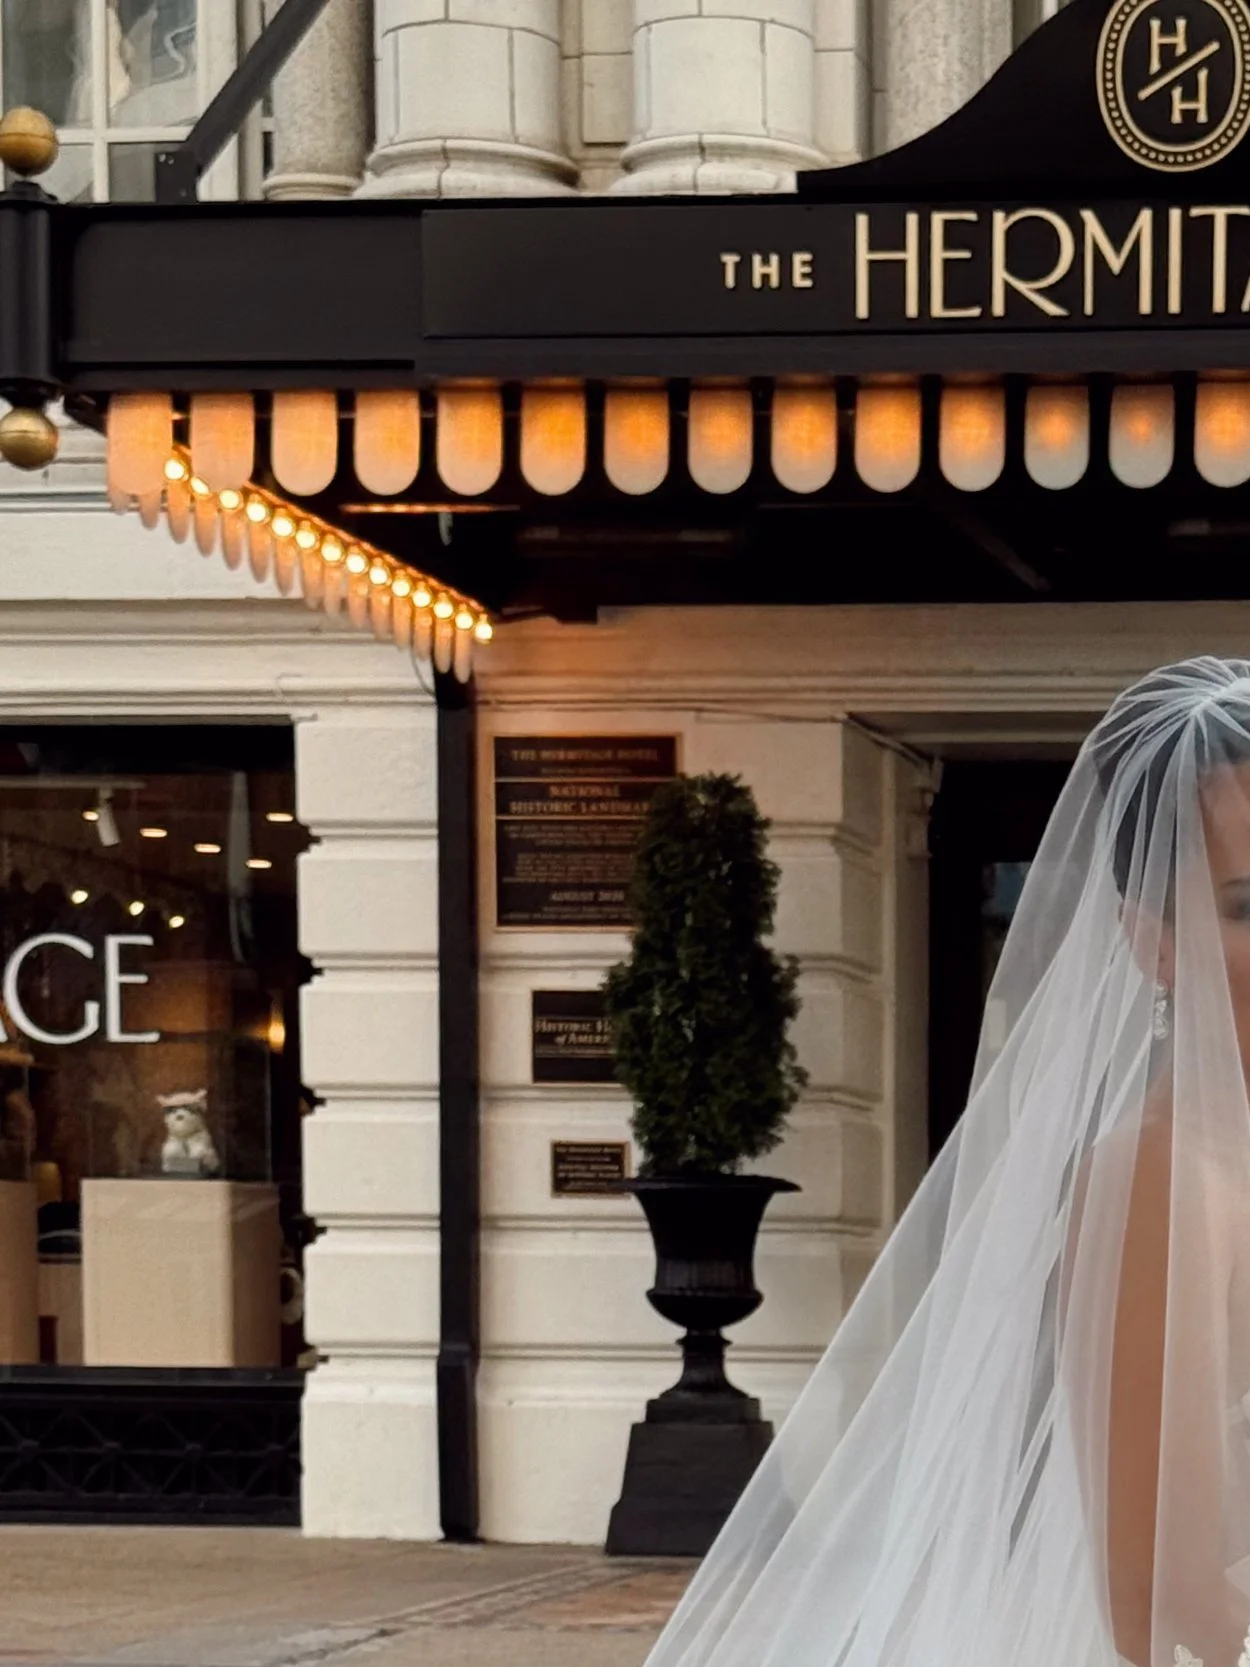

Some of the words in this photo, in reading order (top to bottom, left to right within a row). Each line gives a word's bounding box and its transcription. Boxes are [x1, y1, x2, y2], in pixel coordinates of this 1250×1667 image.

[720, 252, 813, 289] THE
[580, 801, 651, 814] LANDMAR
[0, 933, 160, 1044] GE
